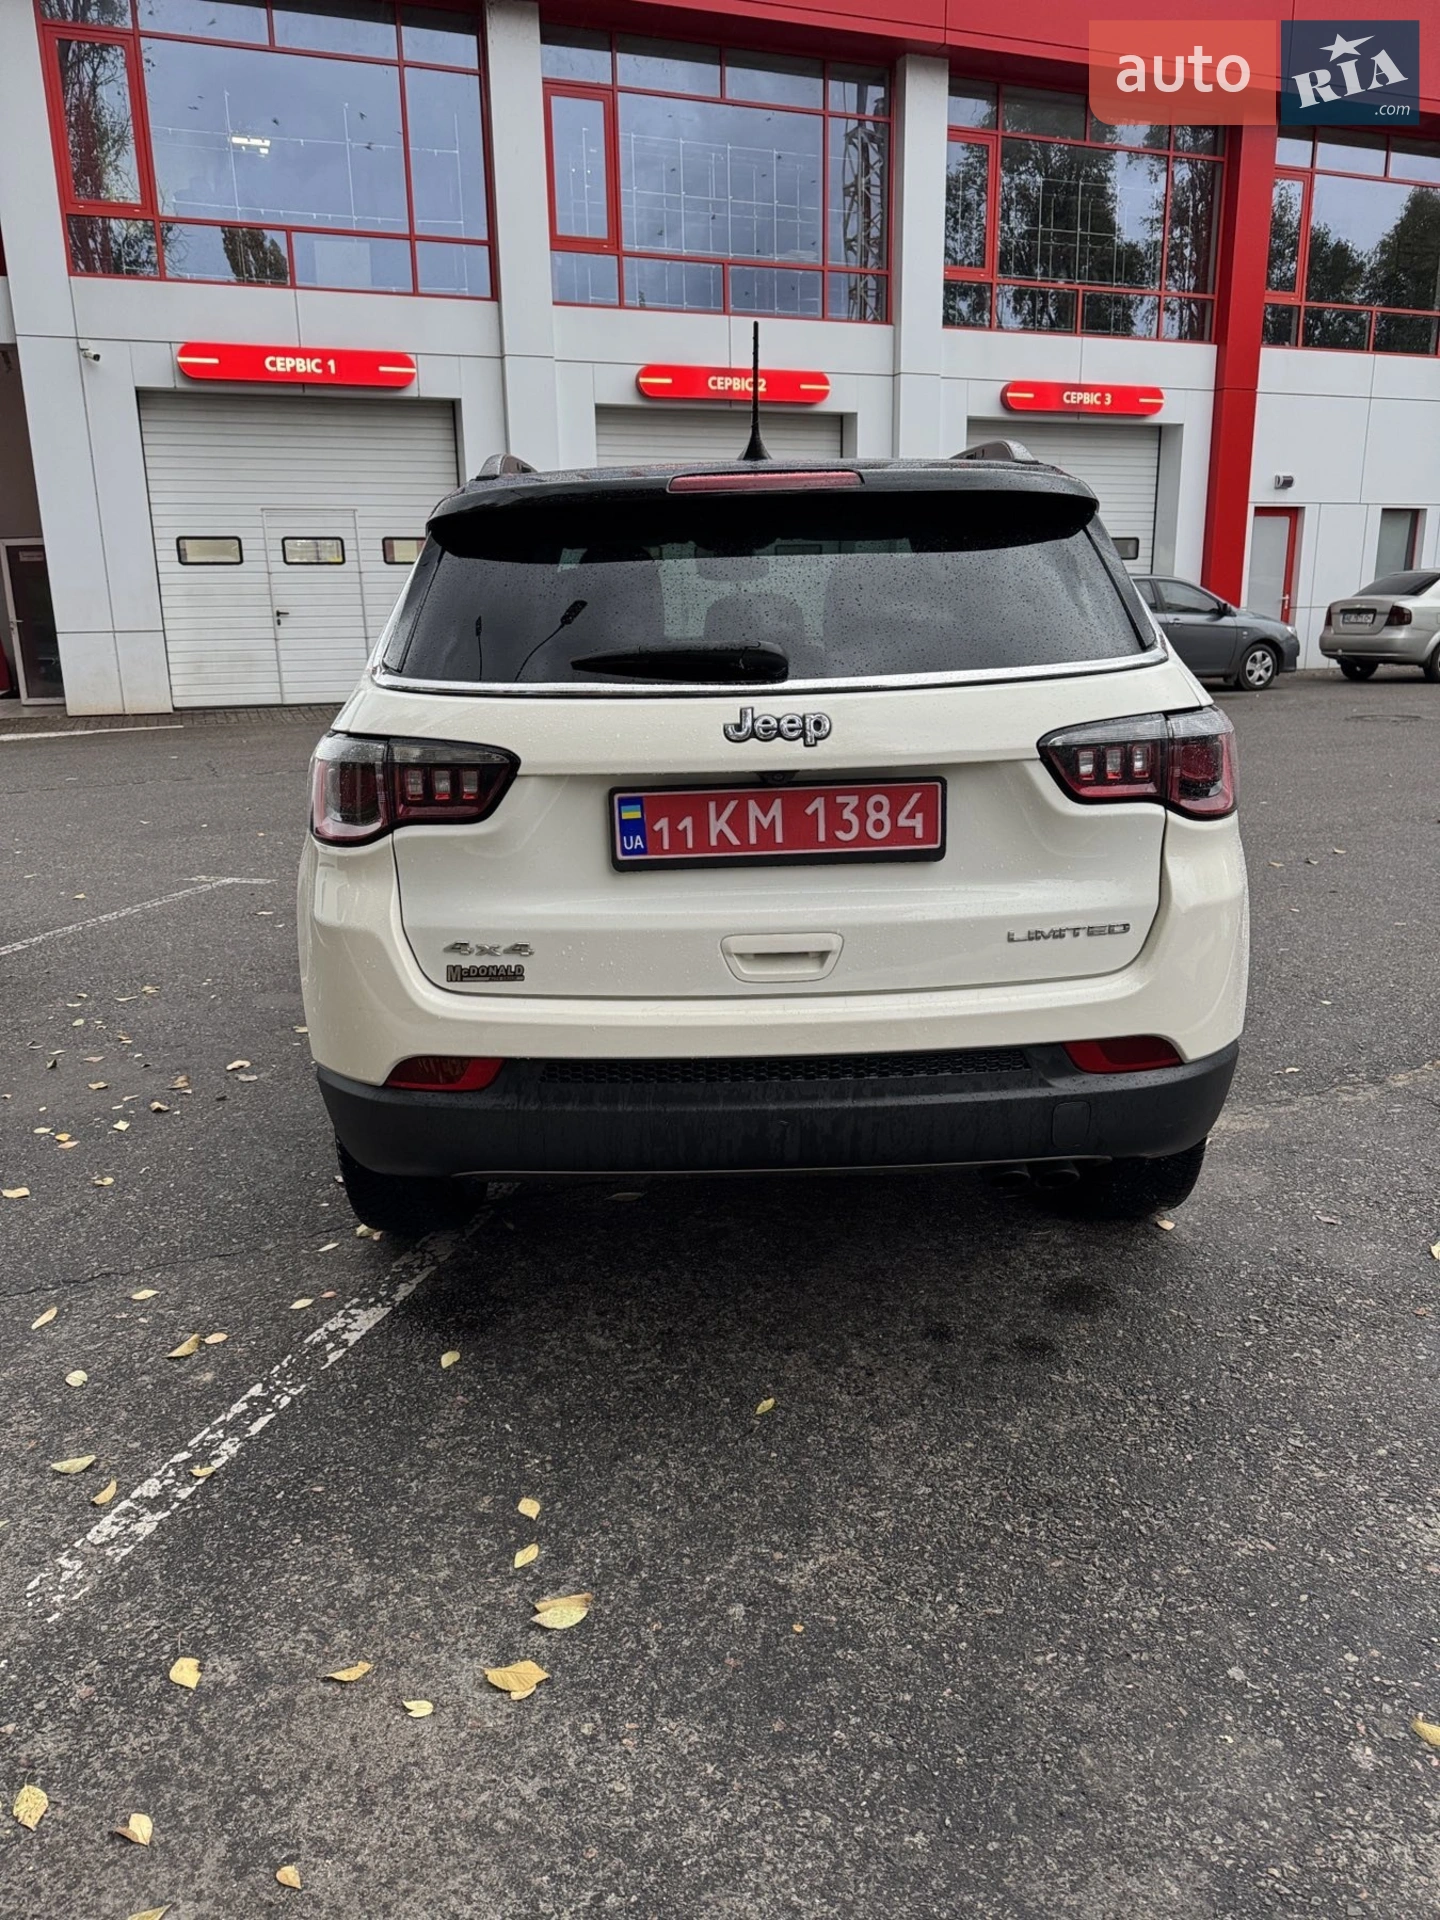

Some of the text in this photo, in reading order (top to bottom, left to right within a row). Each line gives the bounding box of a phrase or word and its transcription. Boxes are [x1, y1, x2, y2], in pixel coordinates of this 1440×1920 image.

[265, 356, 336, 374] СЕРВІС 1
[757, 378, 766, 392] 2
[1063, 391, 1112, 405] СЕРВІС 3
[723, 706, 832, 747] Jeep
[803, 792, 924, 843] 1384
[623, 835, 644, 850] UA
[1007, 923, 1131, 943] LIMITED
